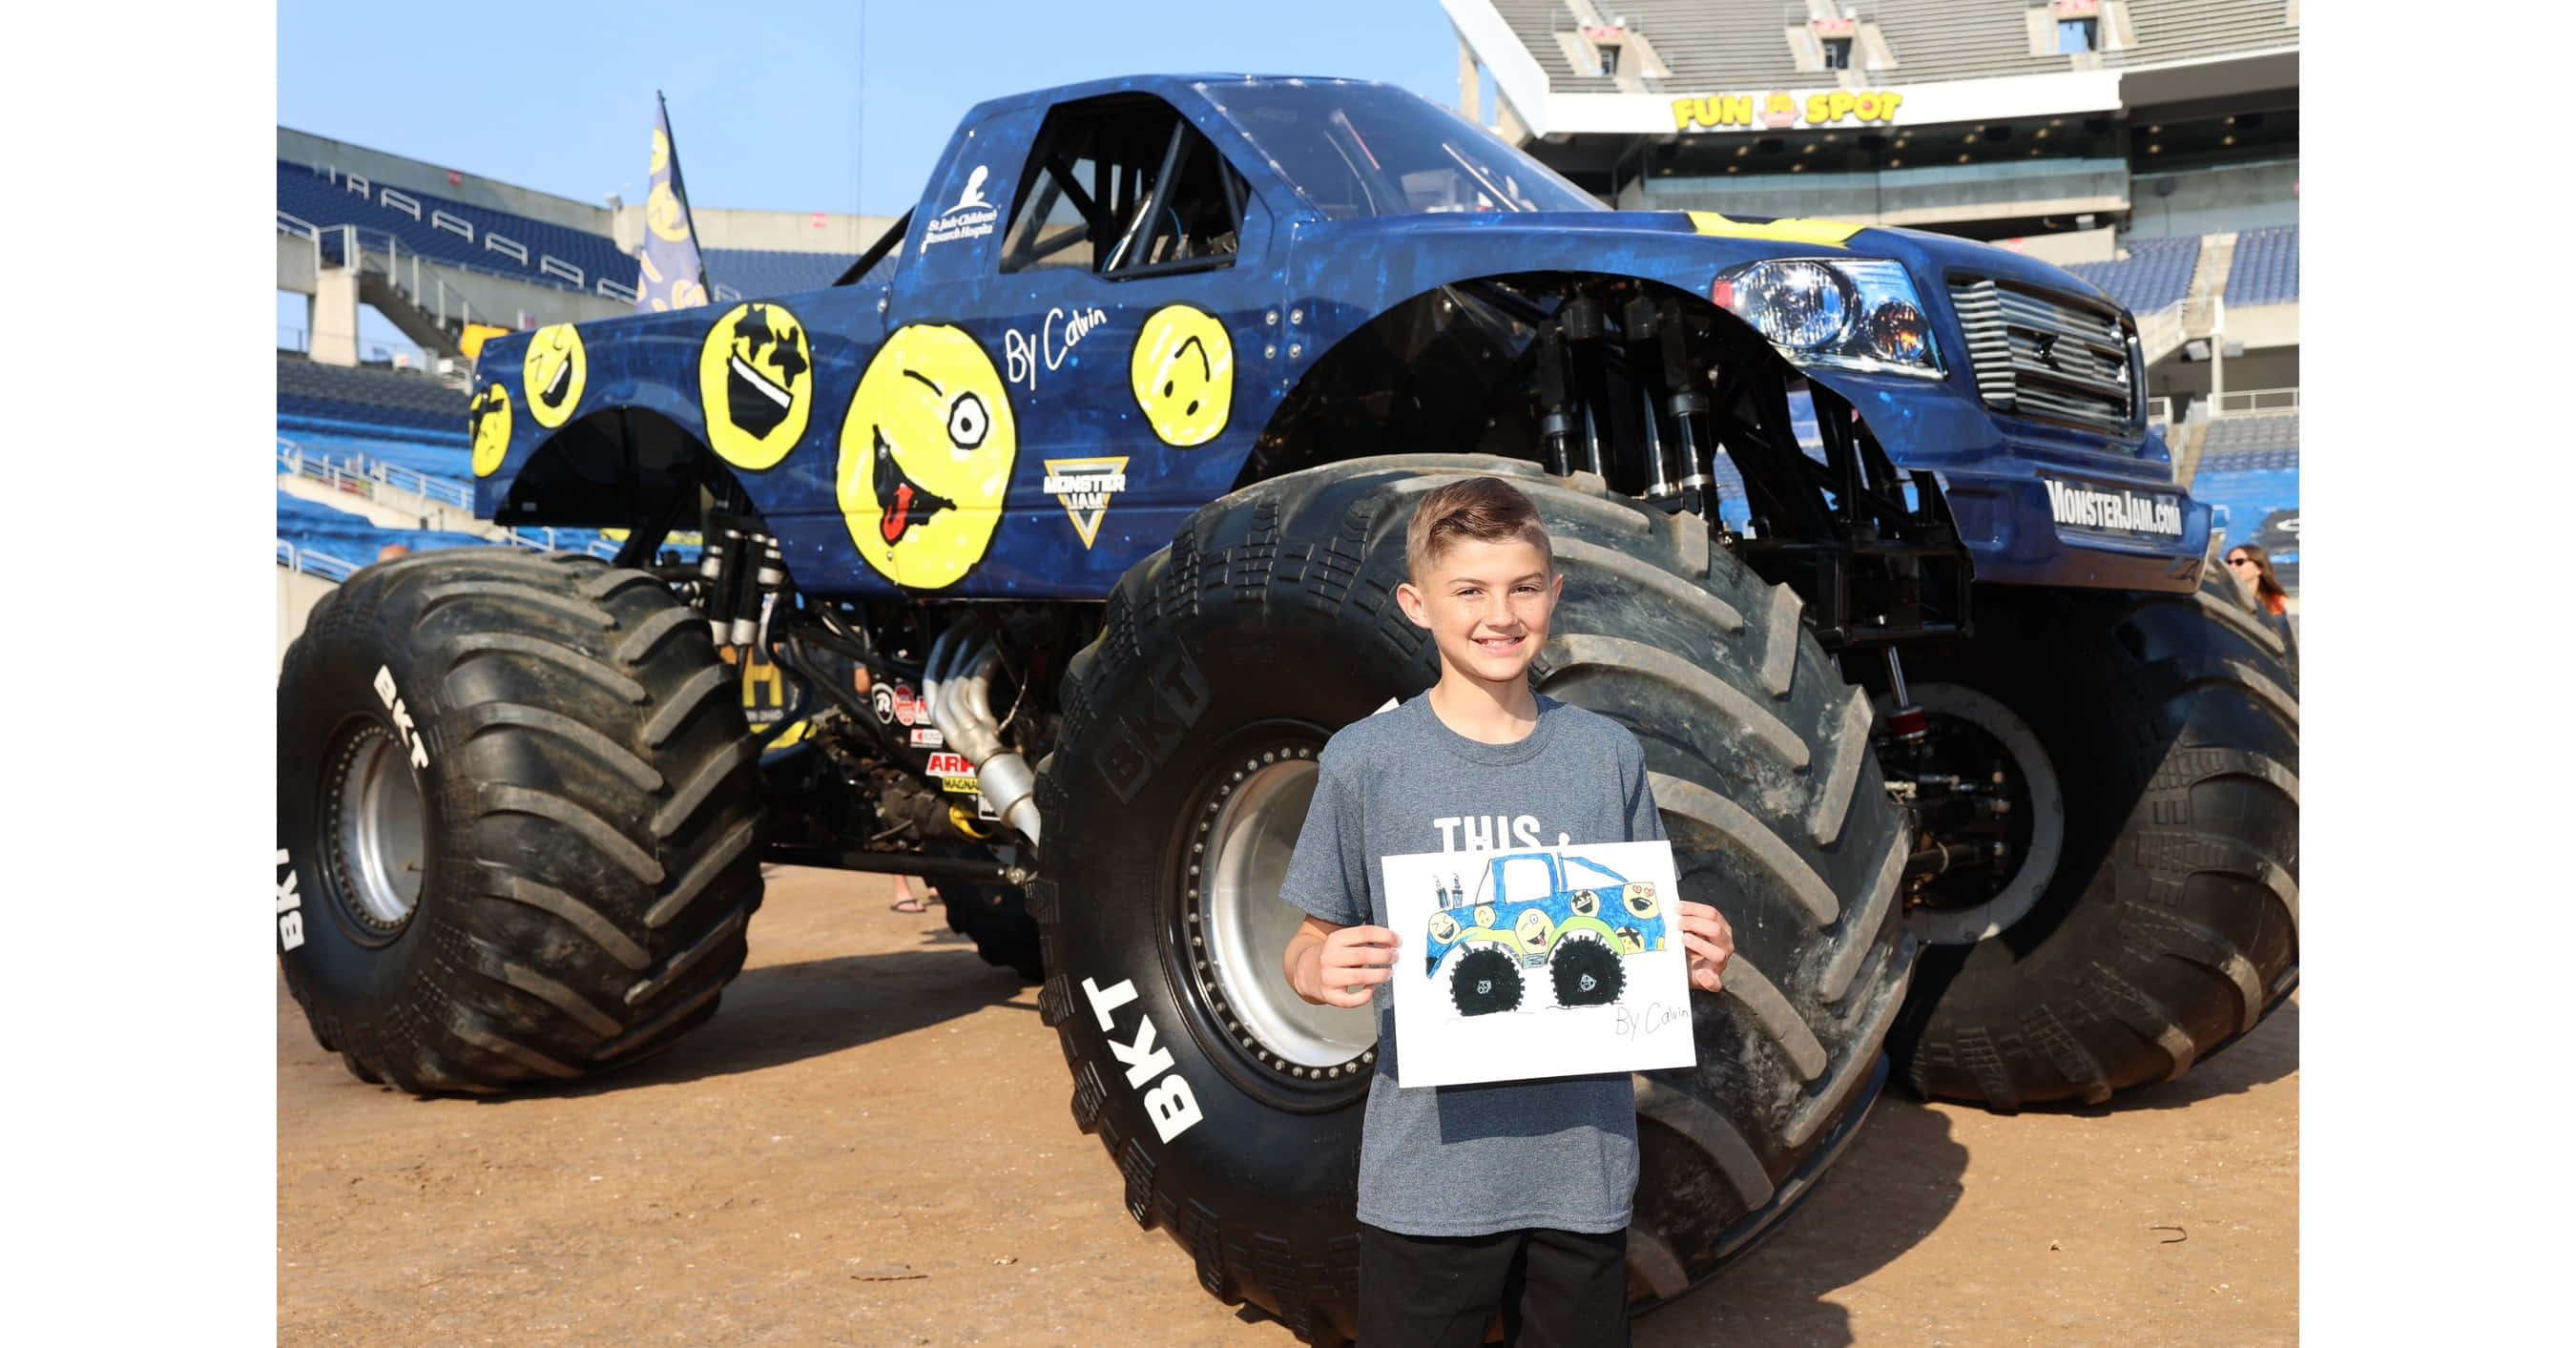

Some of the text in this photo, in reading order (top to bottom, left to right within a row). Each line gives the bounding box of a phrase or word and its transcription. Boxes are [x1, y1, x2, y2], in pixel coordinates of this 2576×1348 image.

[1672, 91, 1903, 131] FUN SPOT
[1005, 307, 1108, 391] By Calvin
[1043, 473, 1126, 494] MONSTER
[1067, 492, 1107, 510] JAM
[373, 664, 429, 770] BKT
[1433, 815, 1542, 854] THIS
[1616, 1002, 1690, 1042] By Calvin
[1081, 976, 1204, 1145] BKT
